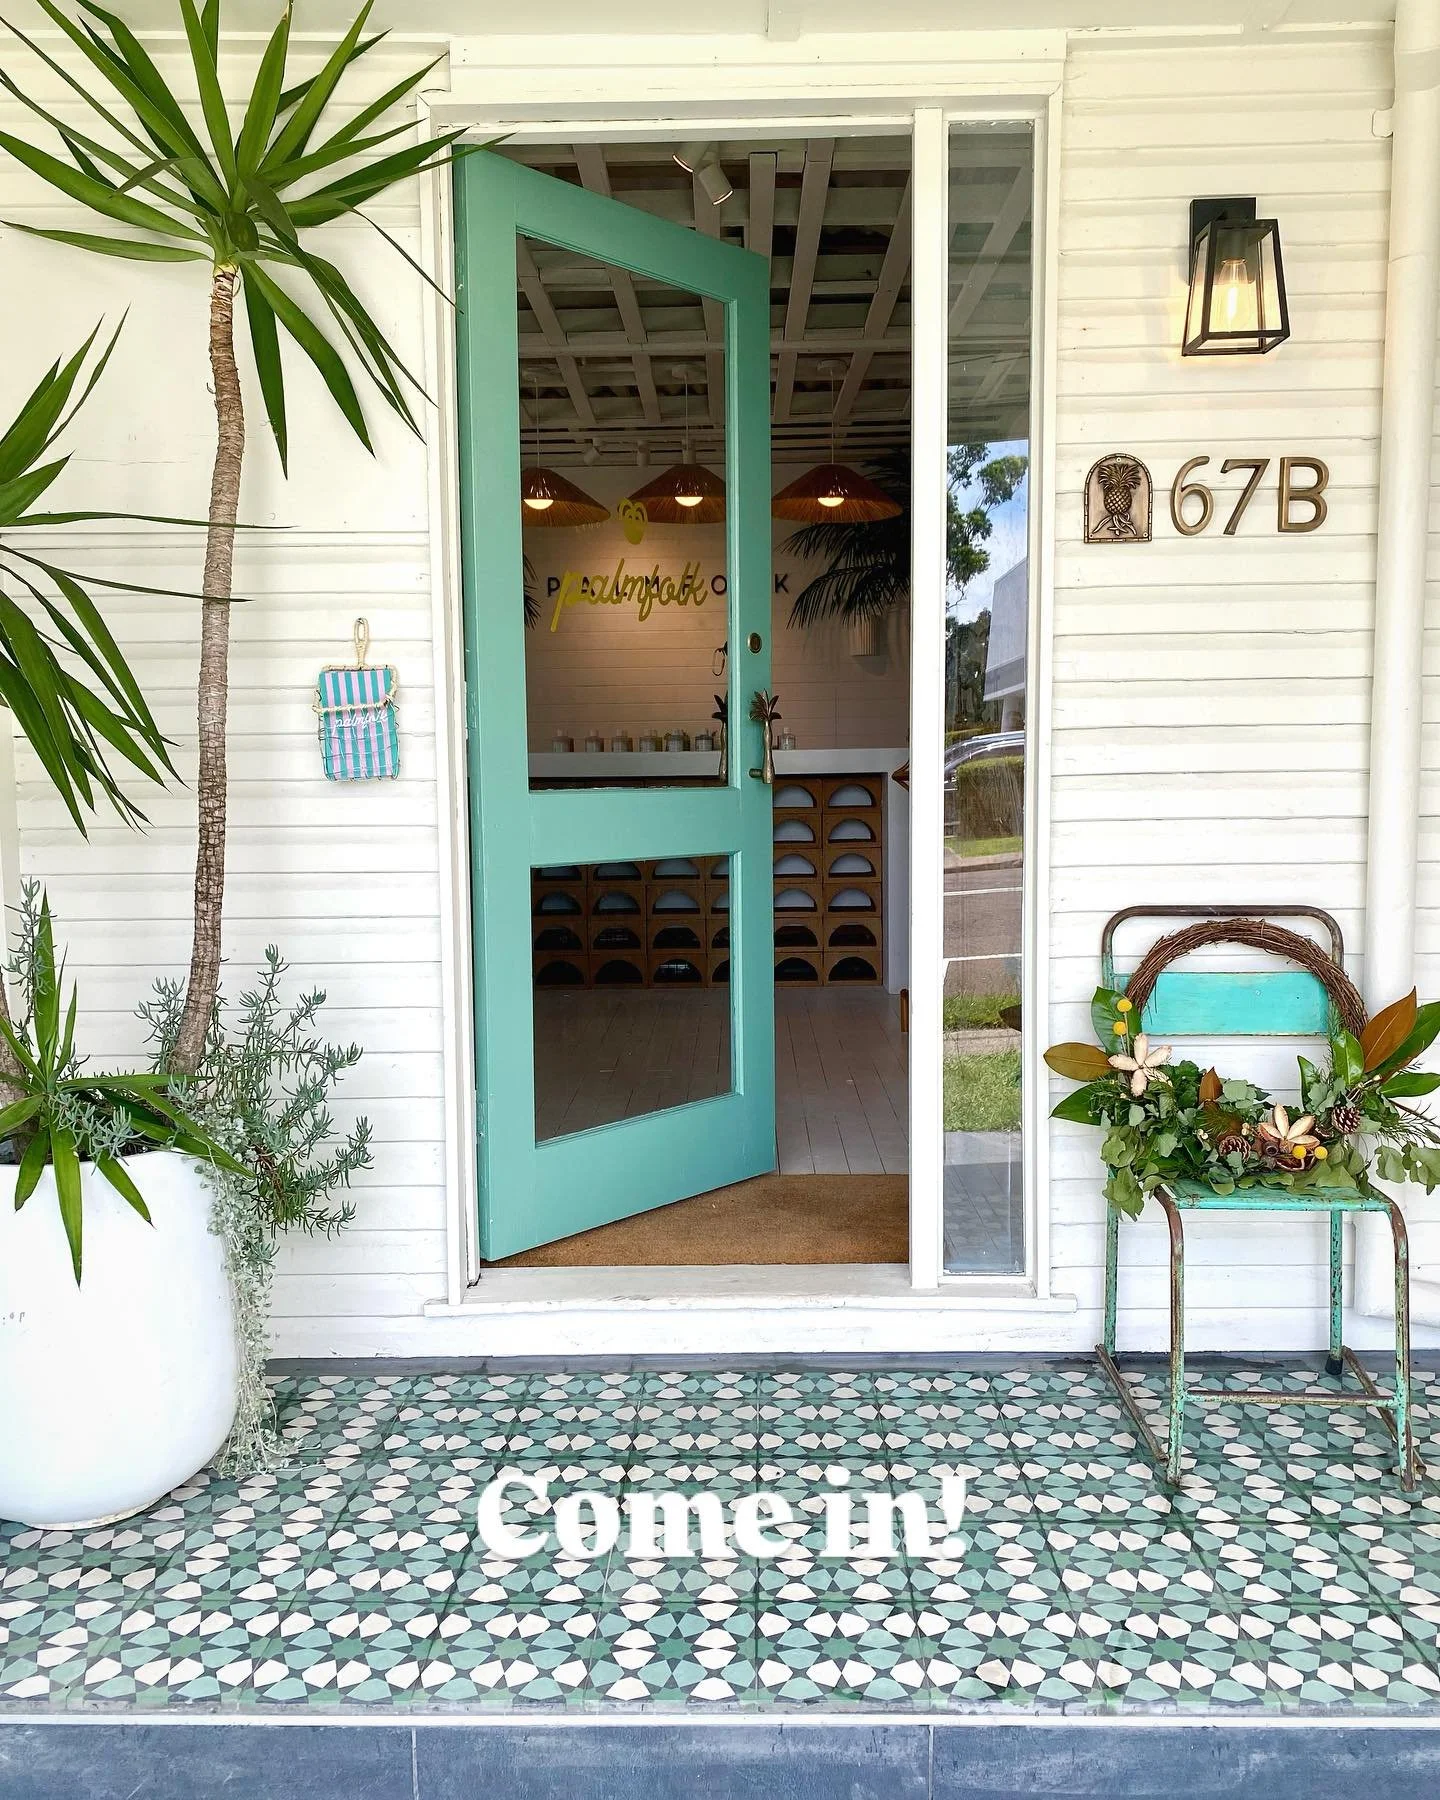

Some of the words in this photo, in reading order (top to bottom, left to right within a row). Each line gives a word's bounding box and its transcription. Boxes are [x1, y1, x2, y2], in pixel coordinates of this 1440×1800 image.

[1169, 455, 1330, 536] 67B
[547, 573, 789, 598] PALMFOK
[551, 557, 708, 633] palmfolk
